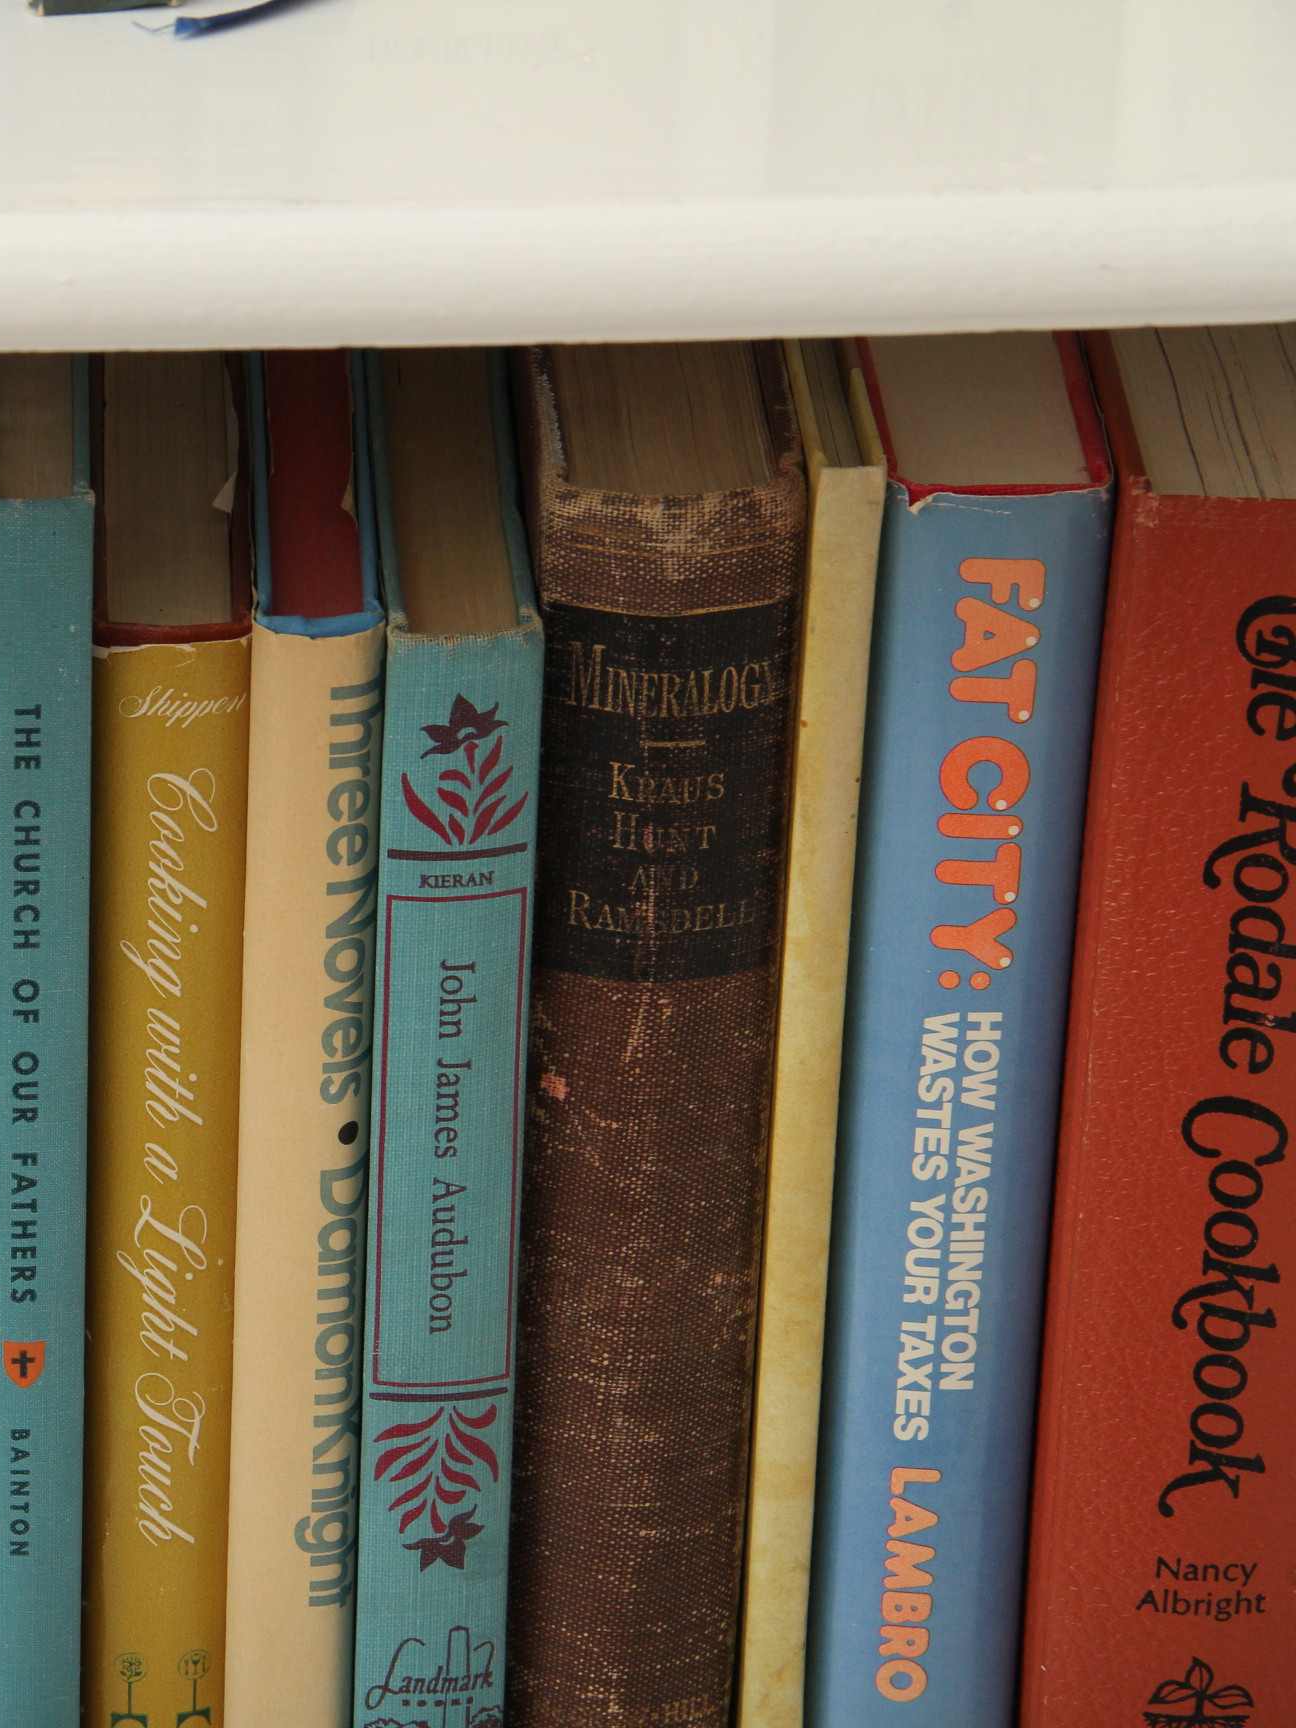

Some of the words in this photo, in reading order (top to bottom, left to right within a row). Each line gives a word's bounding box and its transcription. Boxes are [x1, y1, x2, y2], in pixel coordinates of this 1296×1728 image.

[949, 557, 1047, 724] FAT
[13, 703, 42, 771] THE
[12, 799, 42, 951] CHURCH
[120, 767, 218, 1000] Cooking
[418, 870, 494, 889] KIERAN
[930, 735, 1031, 991] CITY:
[1203, 762, 1296, 1075] Rodale
[11, 978, 40, 1025] OF
[318, 866, 380, 1105] Novels
[438, 959, 478, 1040] John
[10, 1050, 40, 1126] OUR
[144, 1006, 204, 1129] with
[433, 1057, 472, 1160] James
[912, 1012, 960, 1182] WASTES
[960, 1011, 1003, 1111] HOW
[10, 1151, 39, 1305] FATHERS
[143, 1141, 178, 1185] a
[116, 1194, 208, 1363] Light
[314, 1158, 372, 1405] Damon
[429, 1176, 469, 1335] Audubon
[902, 1194, 946, 1305] YOUR
[938, 1122, 995, 1391] WASHINGTON
[1158, 1095, 1289, 1518] Cookbook
[893, 1315, 937, 1442] TAXES
[10, 1428, 31, 1558] BAINTON
[133, 1371, 206, 1548] Touch
[875, 1466, 942, 1702] LAMBRO
[1135, 1589, 1266, 1622] Albright
[1155, 1556, 1258, 1587] Nancy
[365, 1637, 494, 1711] Landmark
